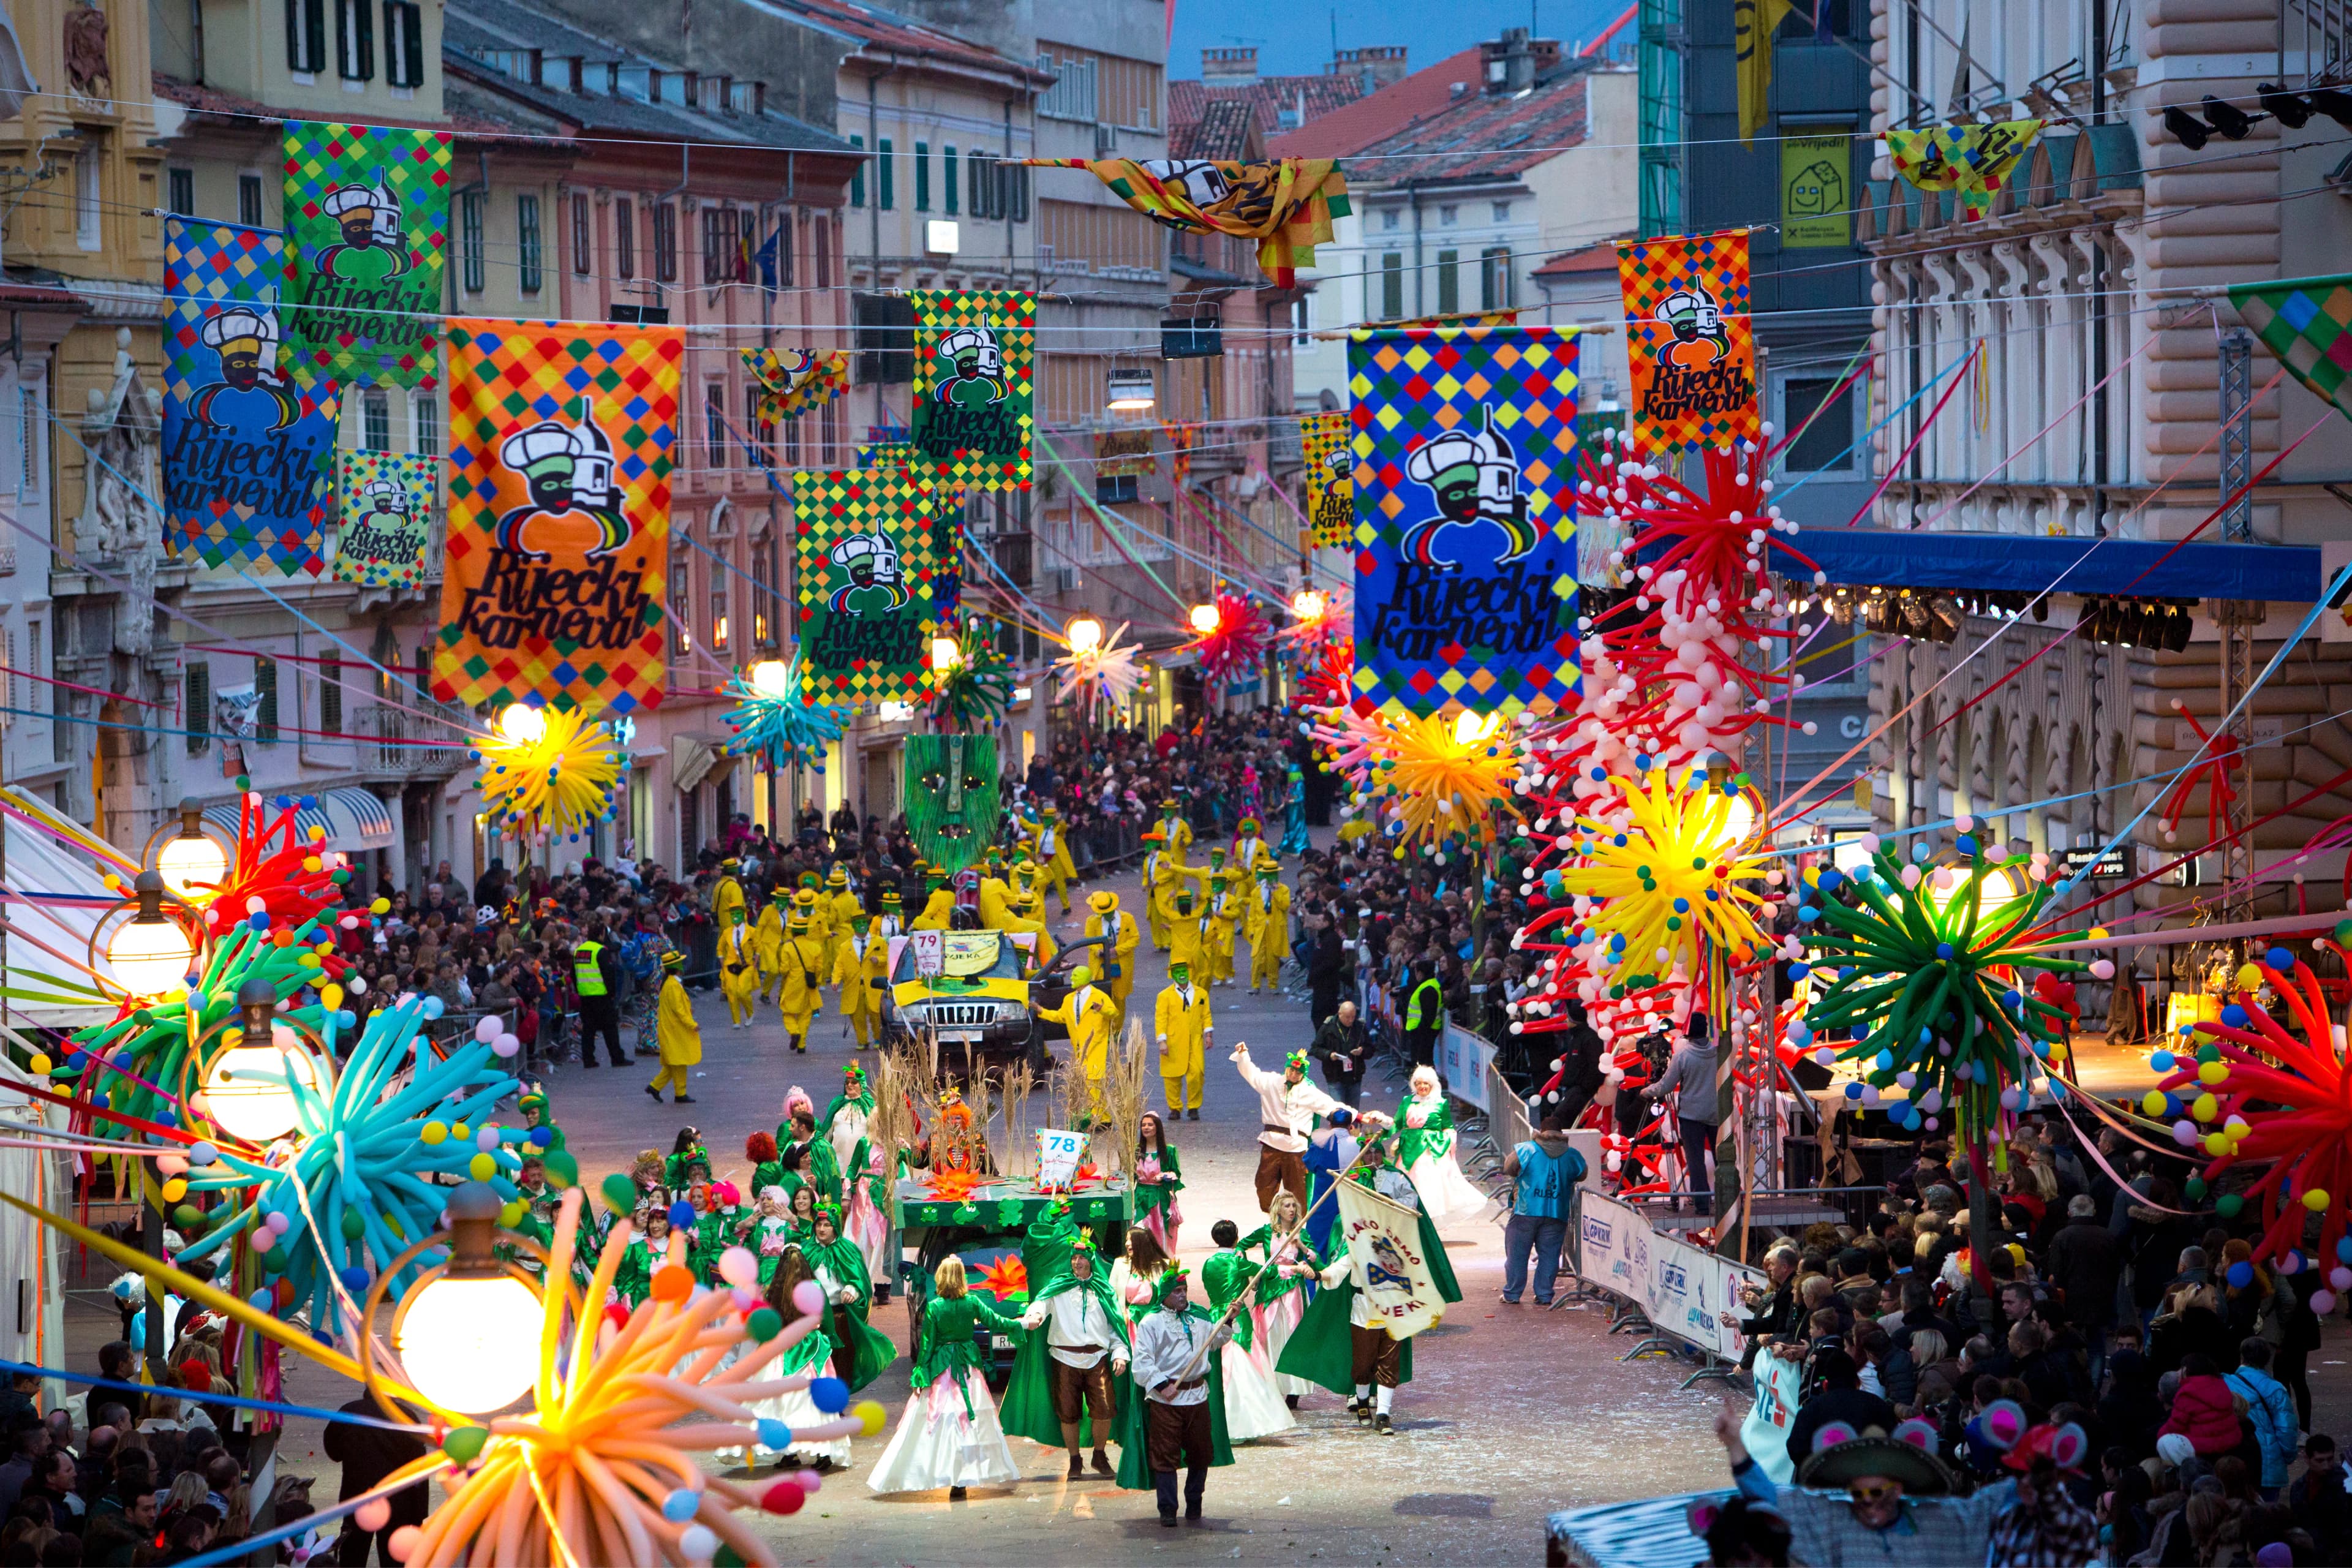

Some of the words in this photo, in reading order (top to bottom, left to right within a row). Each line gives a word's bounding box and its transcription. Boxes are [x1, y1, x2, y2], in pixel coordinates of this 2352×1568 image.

[1643, 377, 1749, 421] karneval
[915, 424, 1023, 458] karneval
[455, 587, 652, 650] karneval
[1371, 595, 1563, 661] karneval
[809, 631, 925, 671] karneval
[2103, 864, 2124, 873] HPB
[919, 935, 937, 948] 79
[1050, 1136, 1075, 1152] 78
